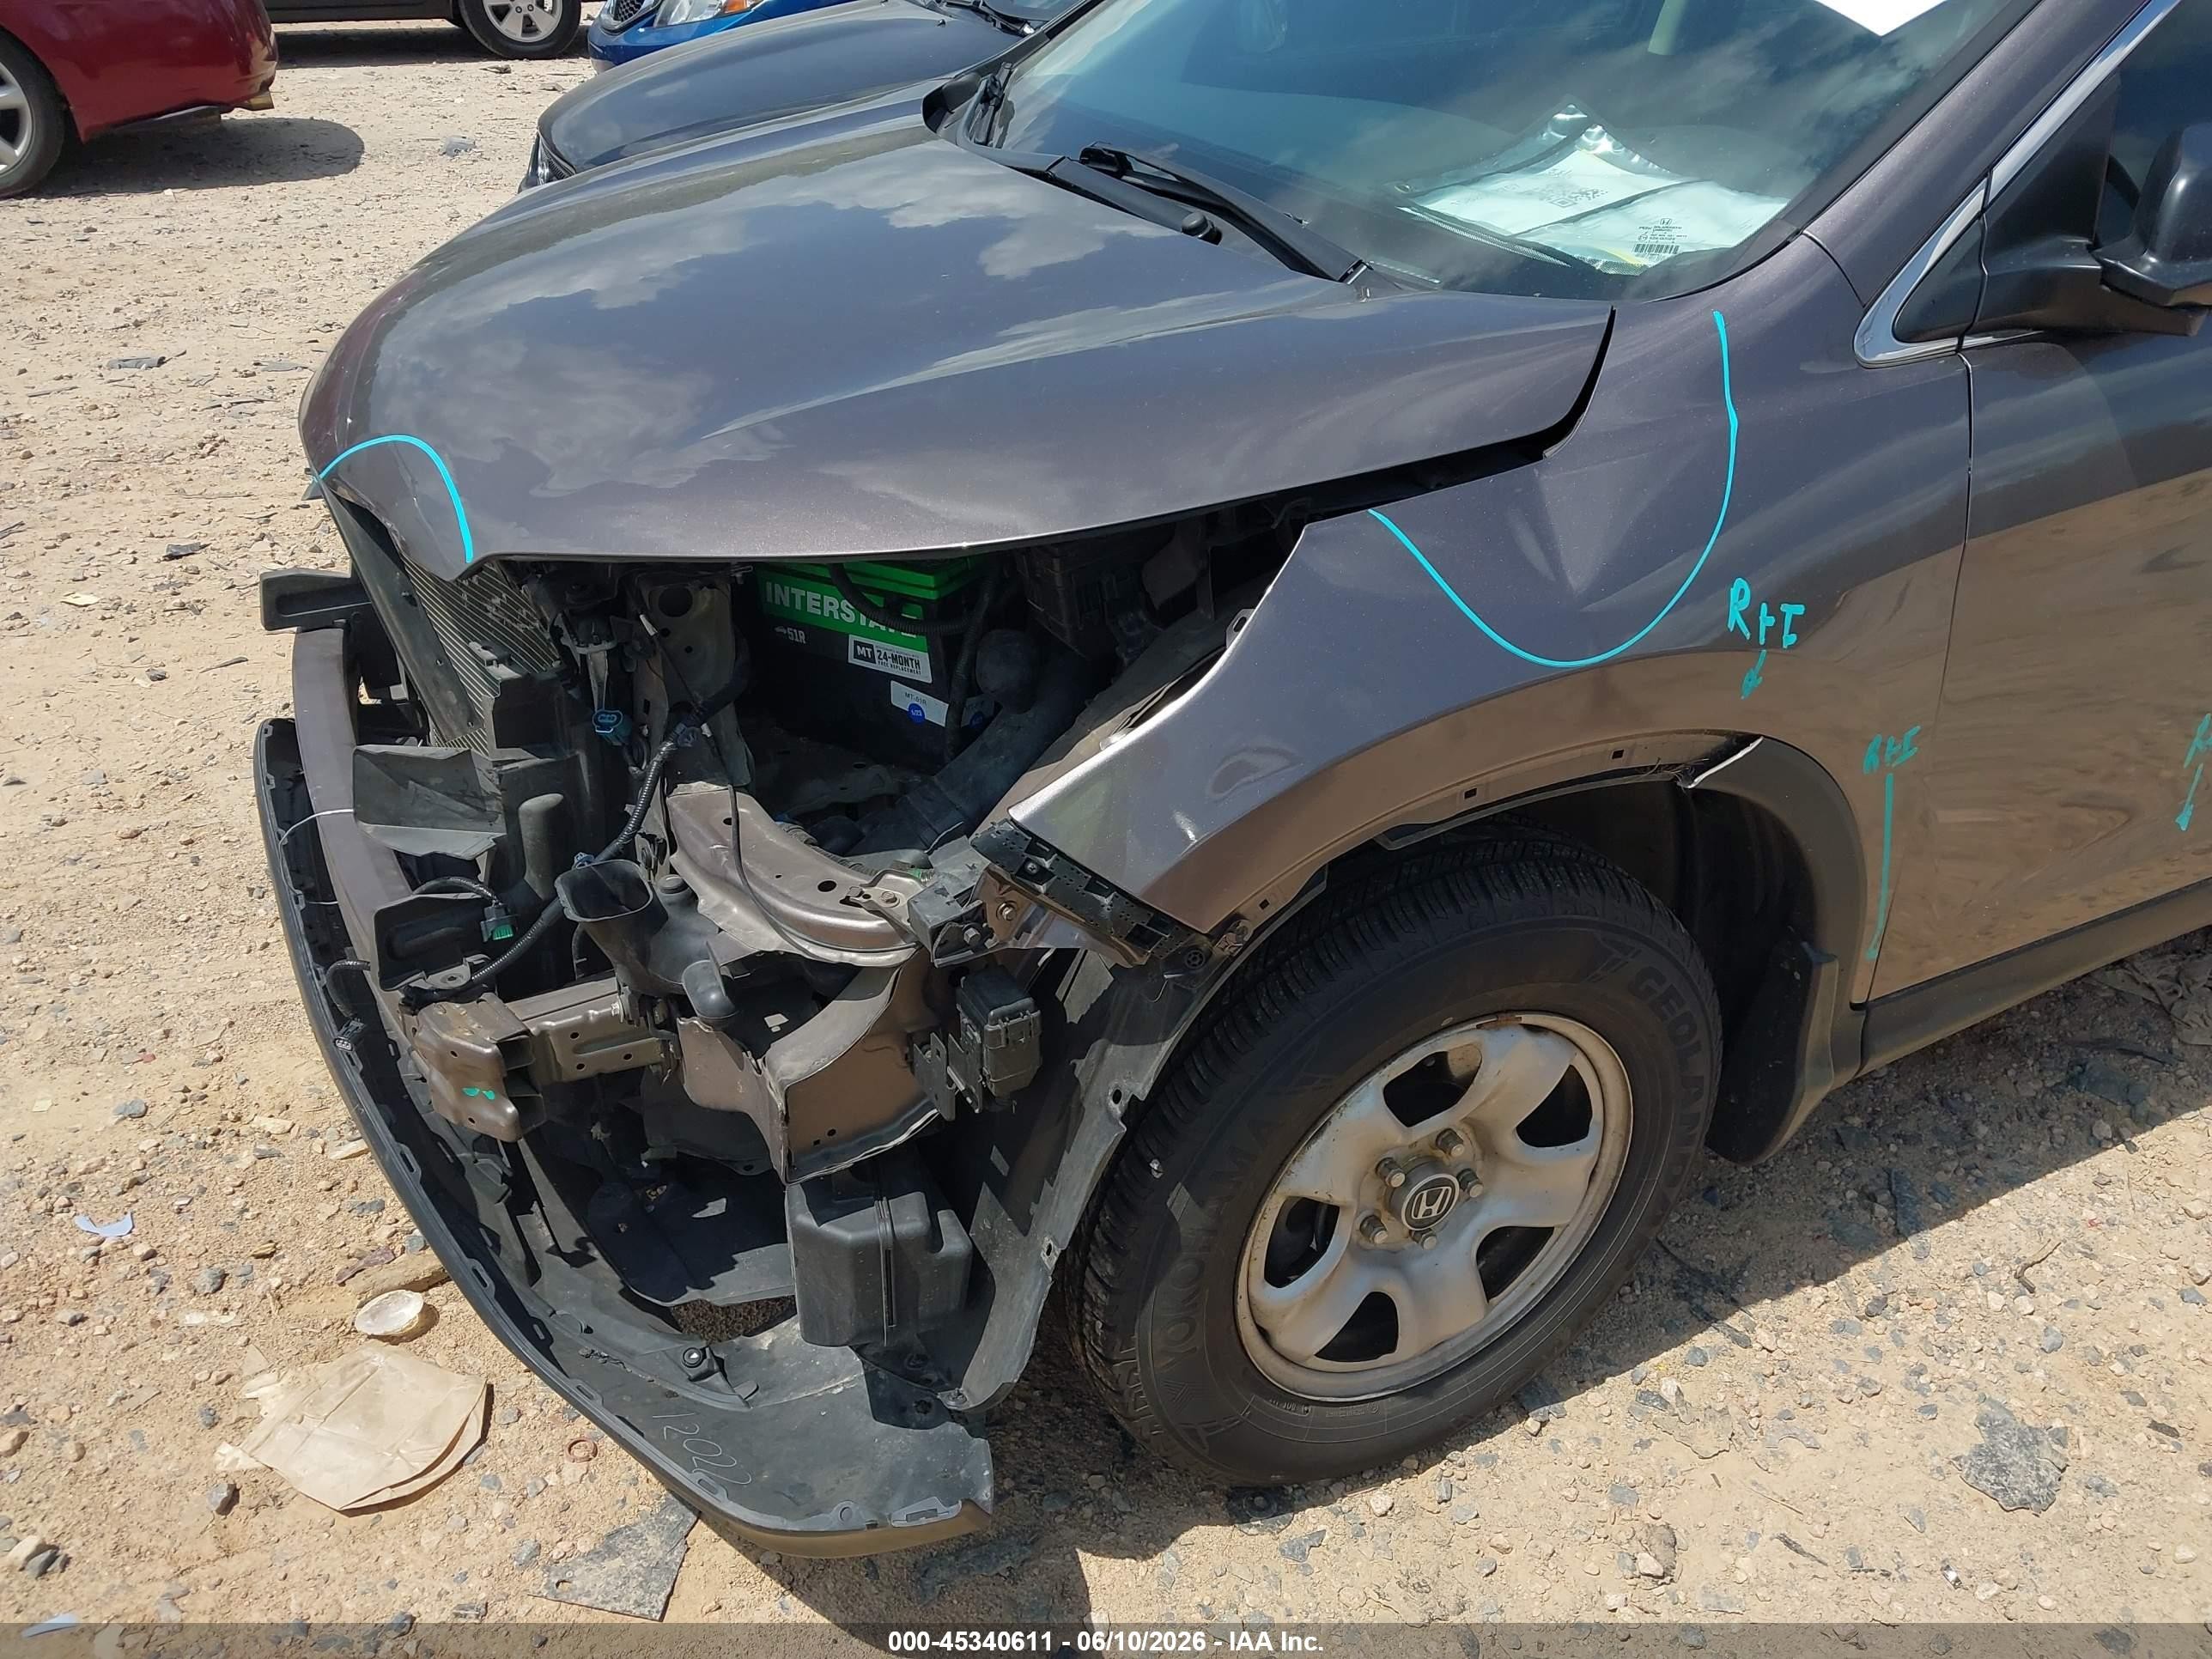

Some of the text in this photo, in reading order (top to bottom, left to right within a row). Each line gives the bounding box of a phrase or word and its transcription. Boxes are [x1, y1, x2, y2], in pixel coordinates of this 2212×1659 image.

[787, 627, 806, 644] 51R
[856, 644, 872, 659] MT
[877, 649, 921, 671] 24-MONTH
